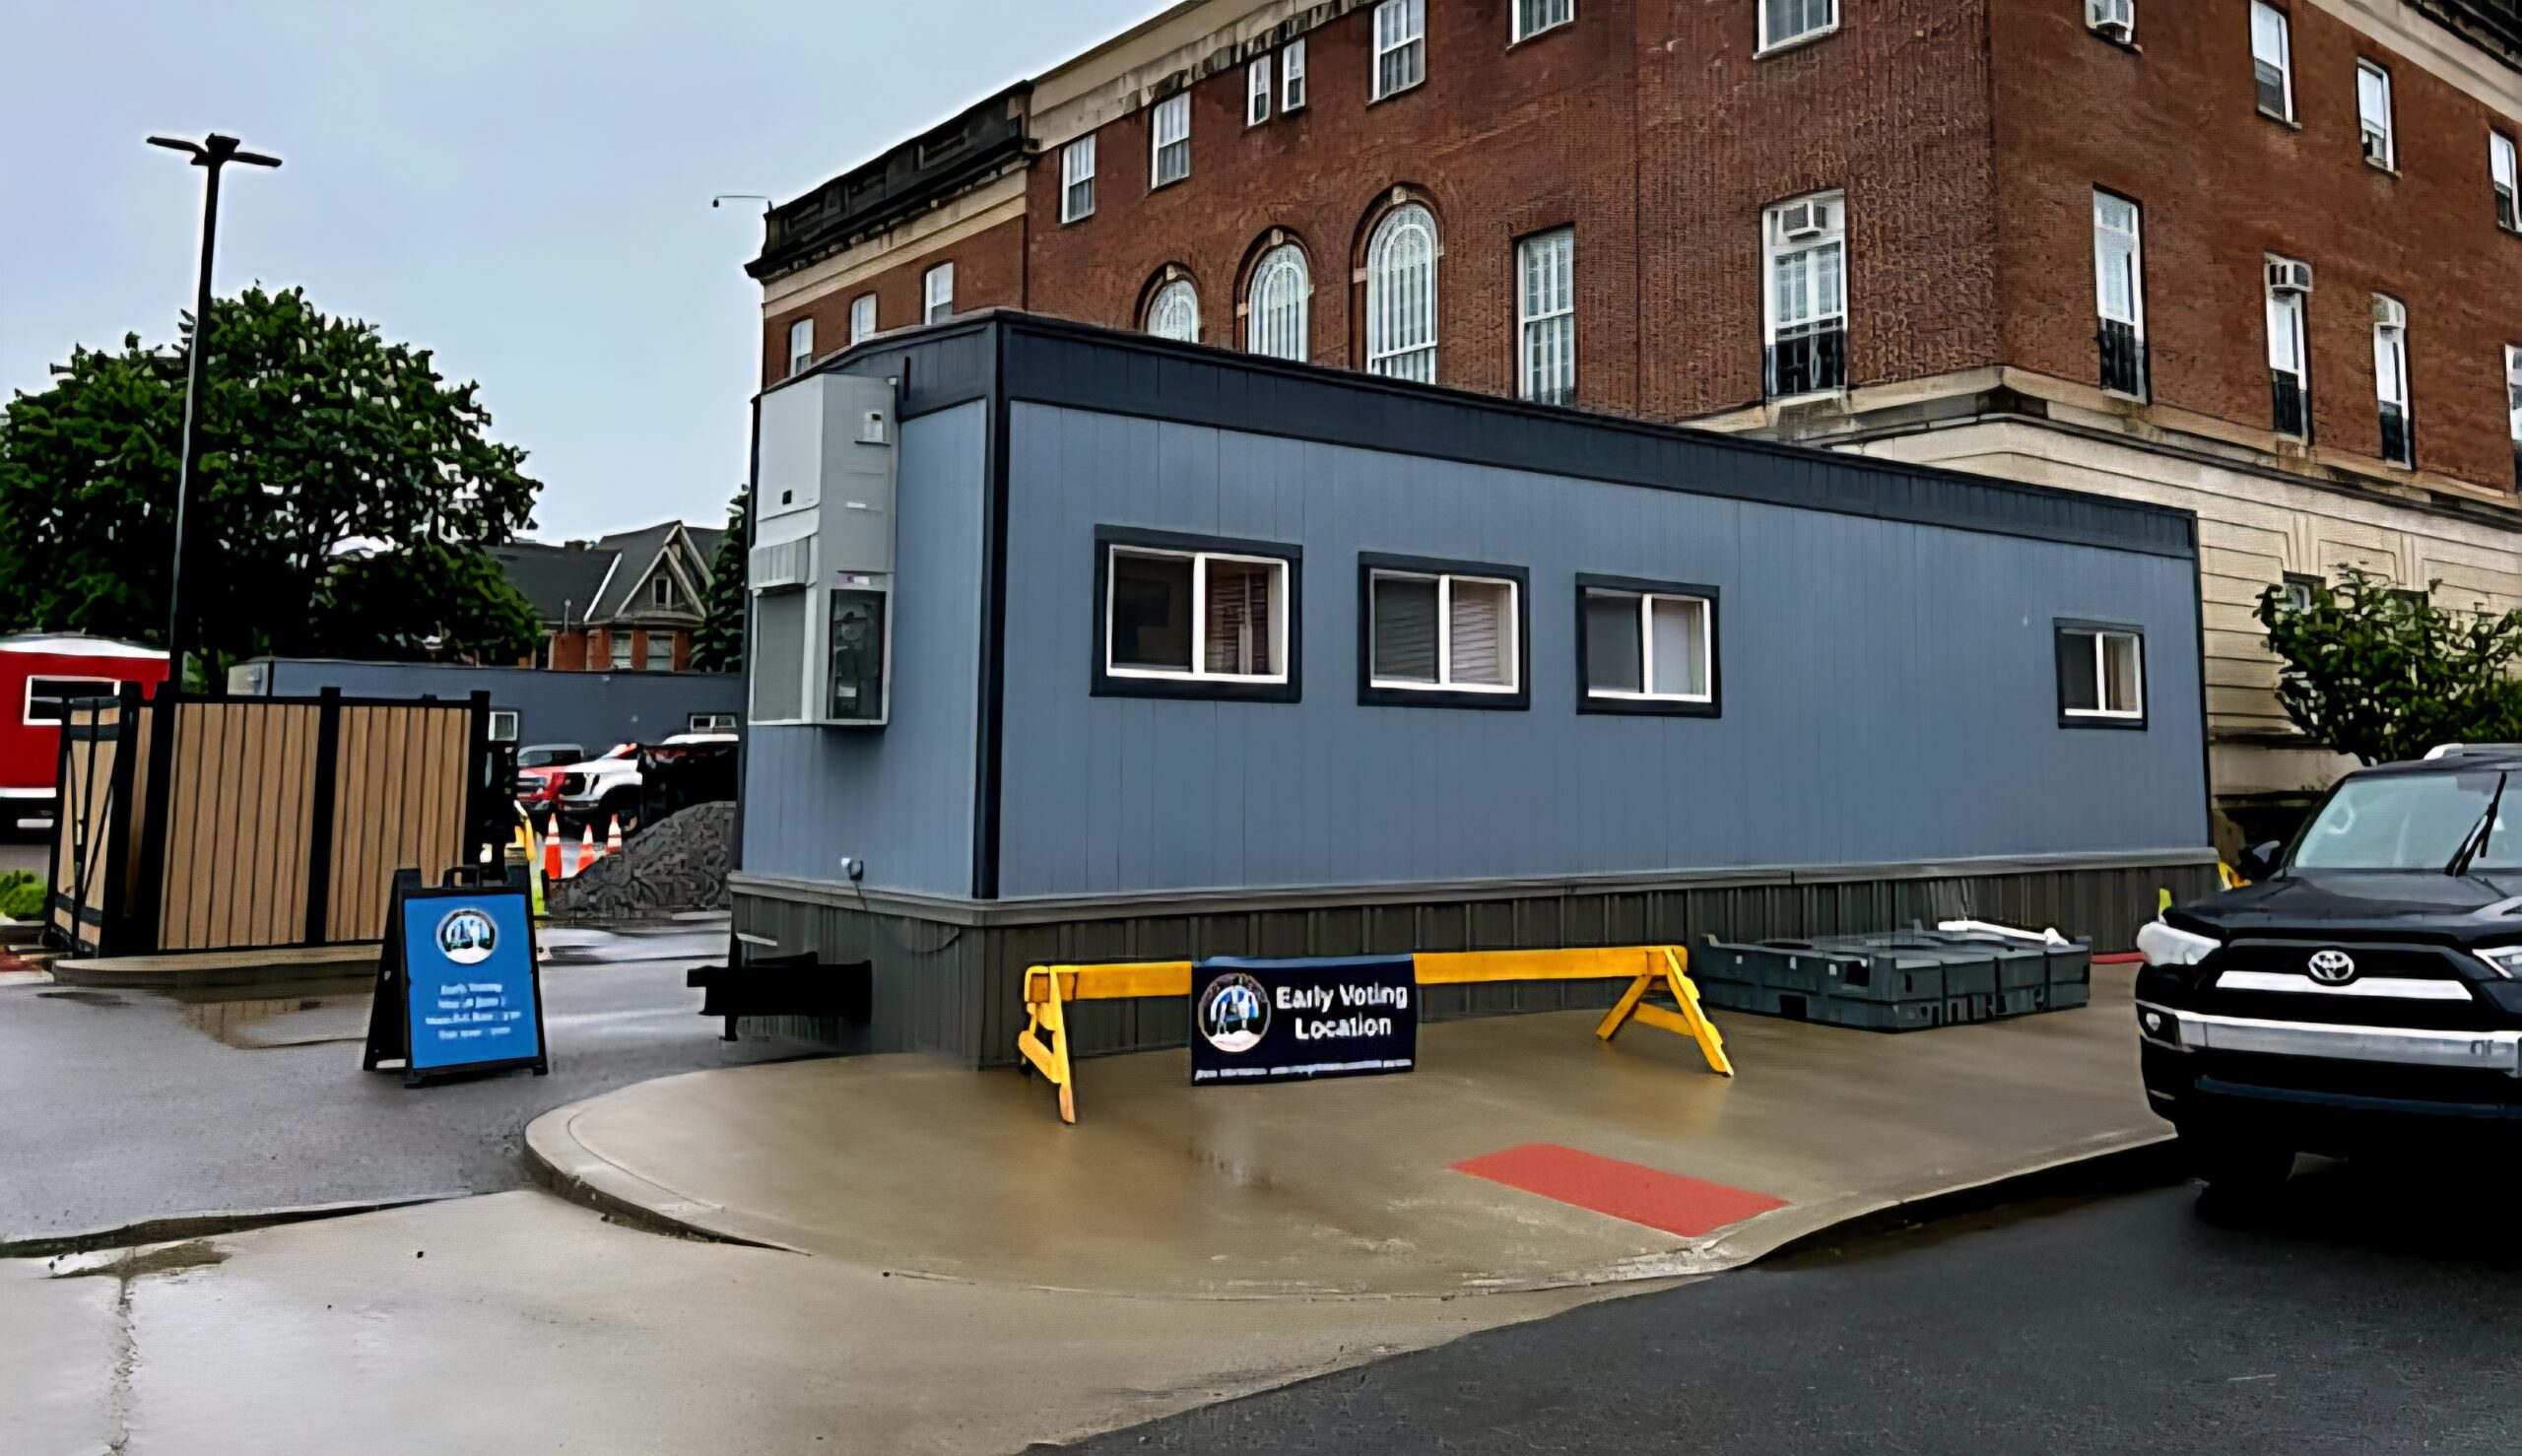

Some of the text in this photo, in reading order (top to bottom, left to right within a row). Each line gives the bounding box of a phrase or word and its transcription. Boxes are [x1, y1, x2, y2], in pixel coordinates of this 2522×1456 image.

[1276, 982, 1408, 1013] Early Voting
[1294, 1012, 1392, 1040] Location
